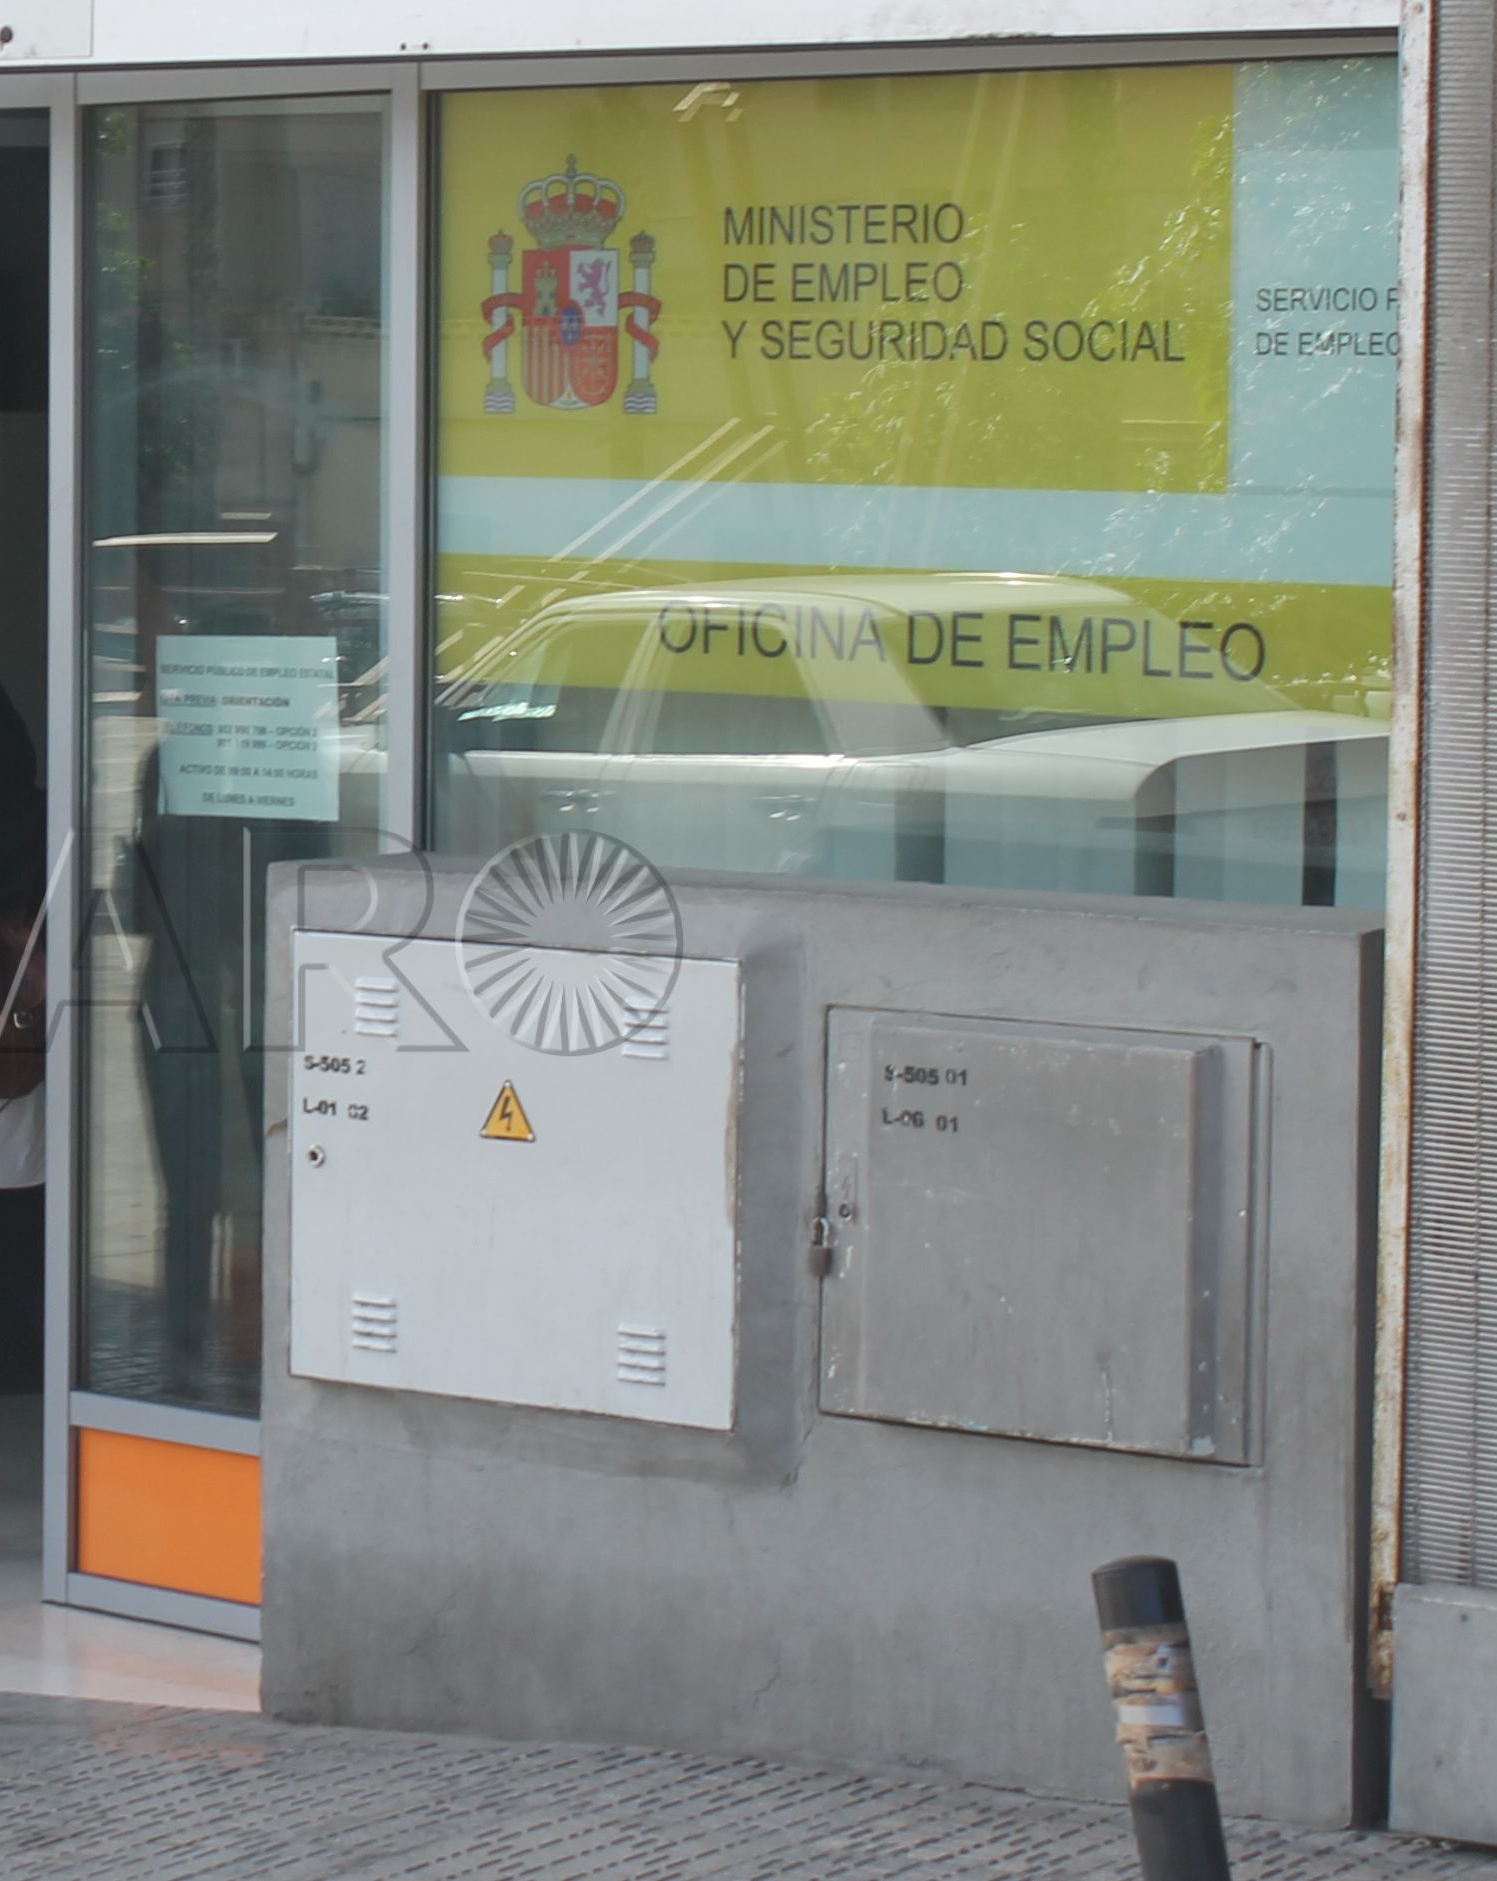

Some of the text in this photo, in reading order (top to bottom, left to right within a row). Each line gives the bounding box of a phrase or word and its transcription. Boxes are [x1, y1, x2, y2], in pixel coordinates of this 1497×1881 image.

[722, 202, 965, 246] MINISTERIO
[722, 261, 965, 303] DE EMPLEO
[1256, 287, 1378, 312] SERVICIO
[721, 319, 1185, 363] Y SEGURIDAD SOCIAL
[1256, 332, 1289, 356] DE
[658, 597, 1266, 683] OFICINA DE EMPLEO
[260, 667, 297, 679] EMPLEO
[304, 1055, 351, 1074] S-505
[884, 1063, 968, 1086] S-505 01
[936, 1114, 958, 1133] 01
